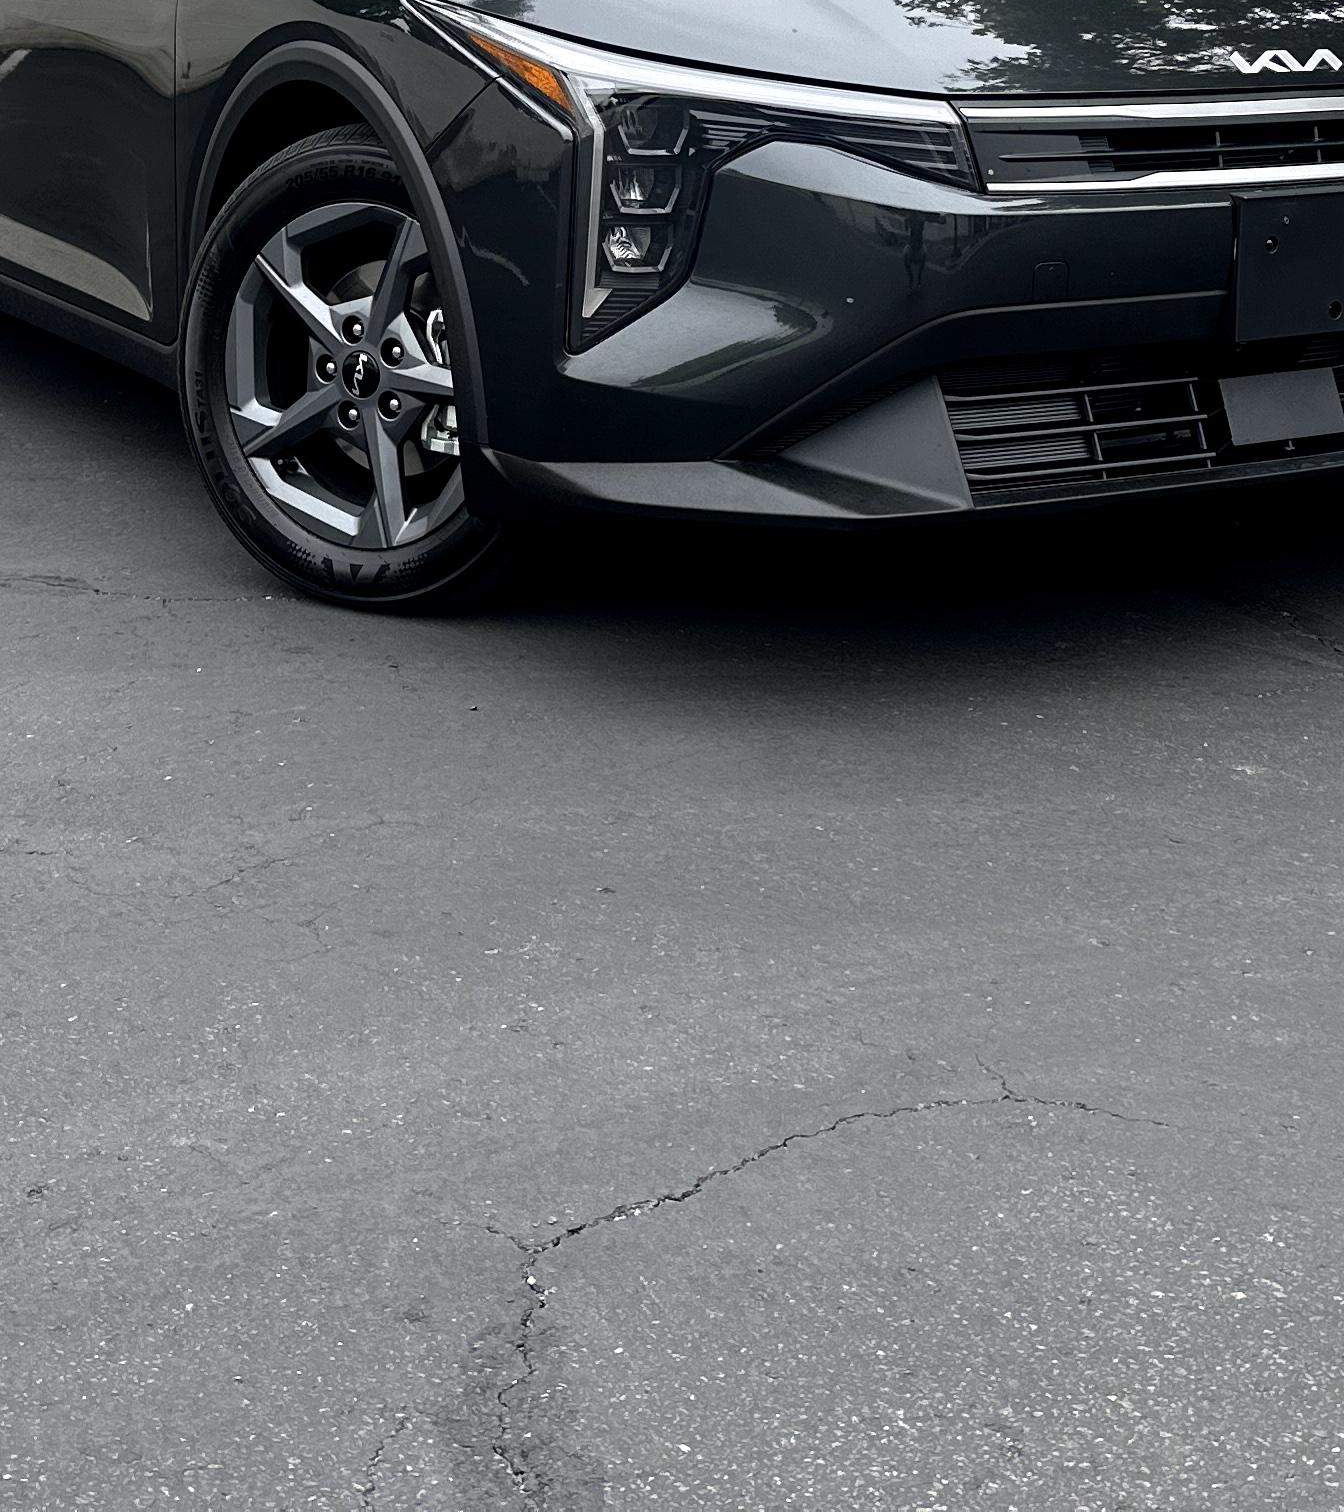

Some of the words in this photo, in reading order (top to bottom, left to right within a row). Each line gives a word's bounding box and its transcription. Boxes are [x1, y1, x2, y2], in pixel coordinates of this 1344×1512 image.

[1230, 49, 1343, 74] KIA
[285, 165, 340, 188] 205/55
[344, 164, 377, 181] R16
